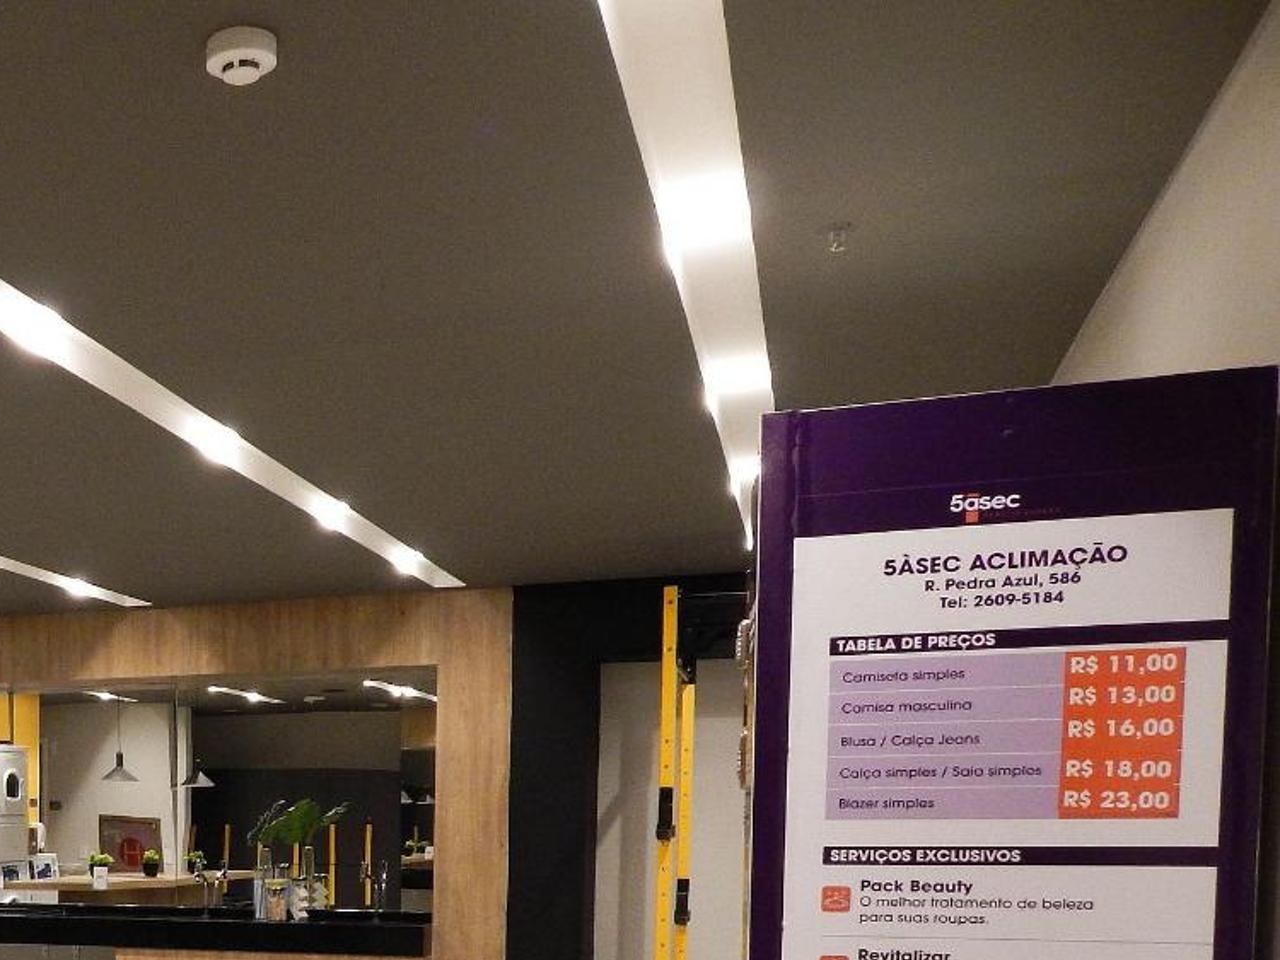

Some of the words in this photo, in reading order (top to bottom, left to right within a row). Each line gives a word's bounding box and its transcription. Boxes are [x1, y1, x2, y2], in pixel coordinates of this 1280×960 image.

[883, 555, 961, 576] 5ÀSEC
[970, 542, 1128, 571] ACLIMAÇÃO
[925, 579, 940, 592] R.
[945, 577, 996, 591] Pedra
[1002, 575, 1043, 588] Azul,
[1049, 571, 1081, 585] 586
[940, 596, 968, 608] Tel:
[974, 592, 1063, 607] 2609-5184
[836, 636, 896, 652] TABELA
[901, 637, 922, 649] DE
[928, 634, 996, 650] PREÇOS
[1071, 655, 1098, 675] R$
[1110, 653, 1178, 675] 11,00
[843, 671, 908, 683] Camiseta
[912, 669, 965, 682] simples
[1070, 686, 1097, 706] R$
[1108, 685, 1176, 707] 13,00
[841, 702, 894, 714] Camisa
[899, 700, 972, 712] masculina
[1068, 719, 1096, 738] R$
[1107, 718, 1174, 739] 16,00
[841, 736, 876, 747] Blusa
[880, 736, 886, 747] /
[891, 735, 934, 748] Calça
[938, 734, 980, 745] Jeans
[840, 767, 881, 780] Calça
[886, 767, 937, 779] simples
[942, 767, 948, 778] /
[988, 765, 1042, 777] simples
[1066, 759, 1093, 778] R$
[1105, 760, 1171, 781] 18,00
[839, 798, 878, 810] Blazer
[882, 798, 934, 810] simples
[1064, 790, 1091, 808] R$
[1100, 791, 1169, 812] 23,00
[830, 850, 912, 864] SERVIÇOS
[916, 850, 1021, 862] EXCLUSIVOS
[861, 880, 903, 892] Pack
[911, 881, 973, 895] Beauty
[860, 897, 871, 907] O
[876, 897, 926, 907] melhor
[931, 897, 1012, 908] tratamento
[1017, 900, 1037, 909] de
[1042, 898, 1094, 910] beleza
[859, 912, 893, 924] para
[898, 914, 929, 923] suas
[933, 914, 989, 925] roupas.
